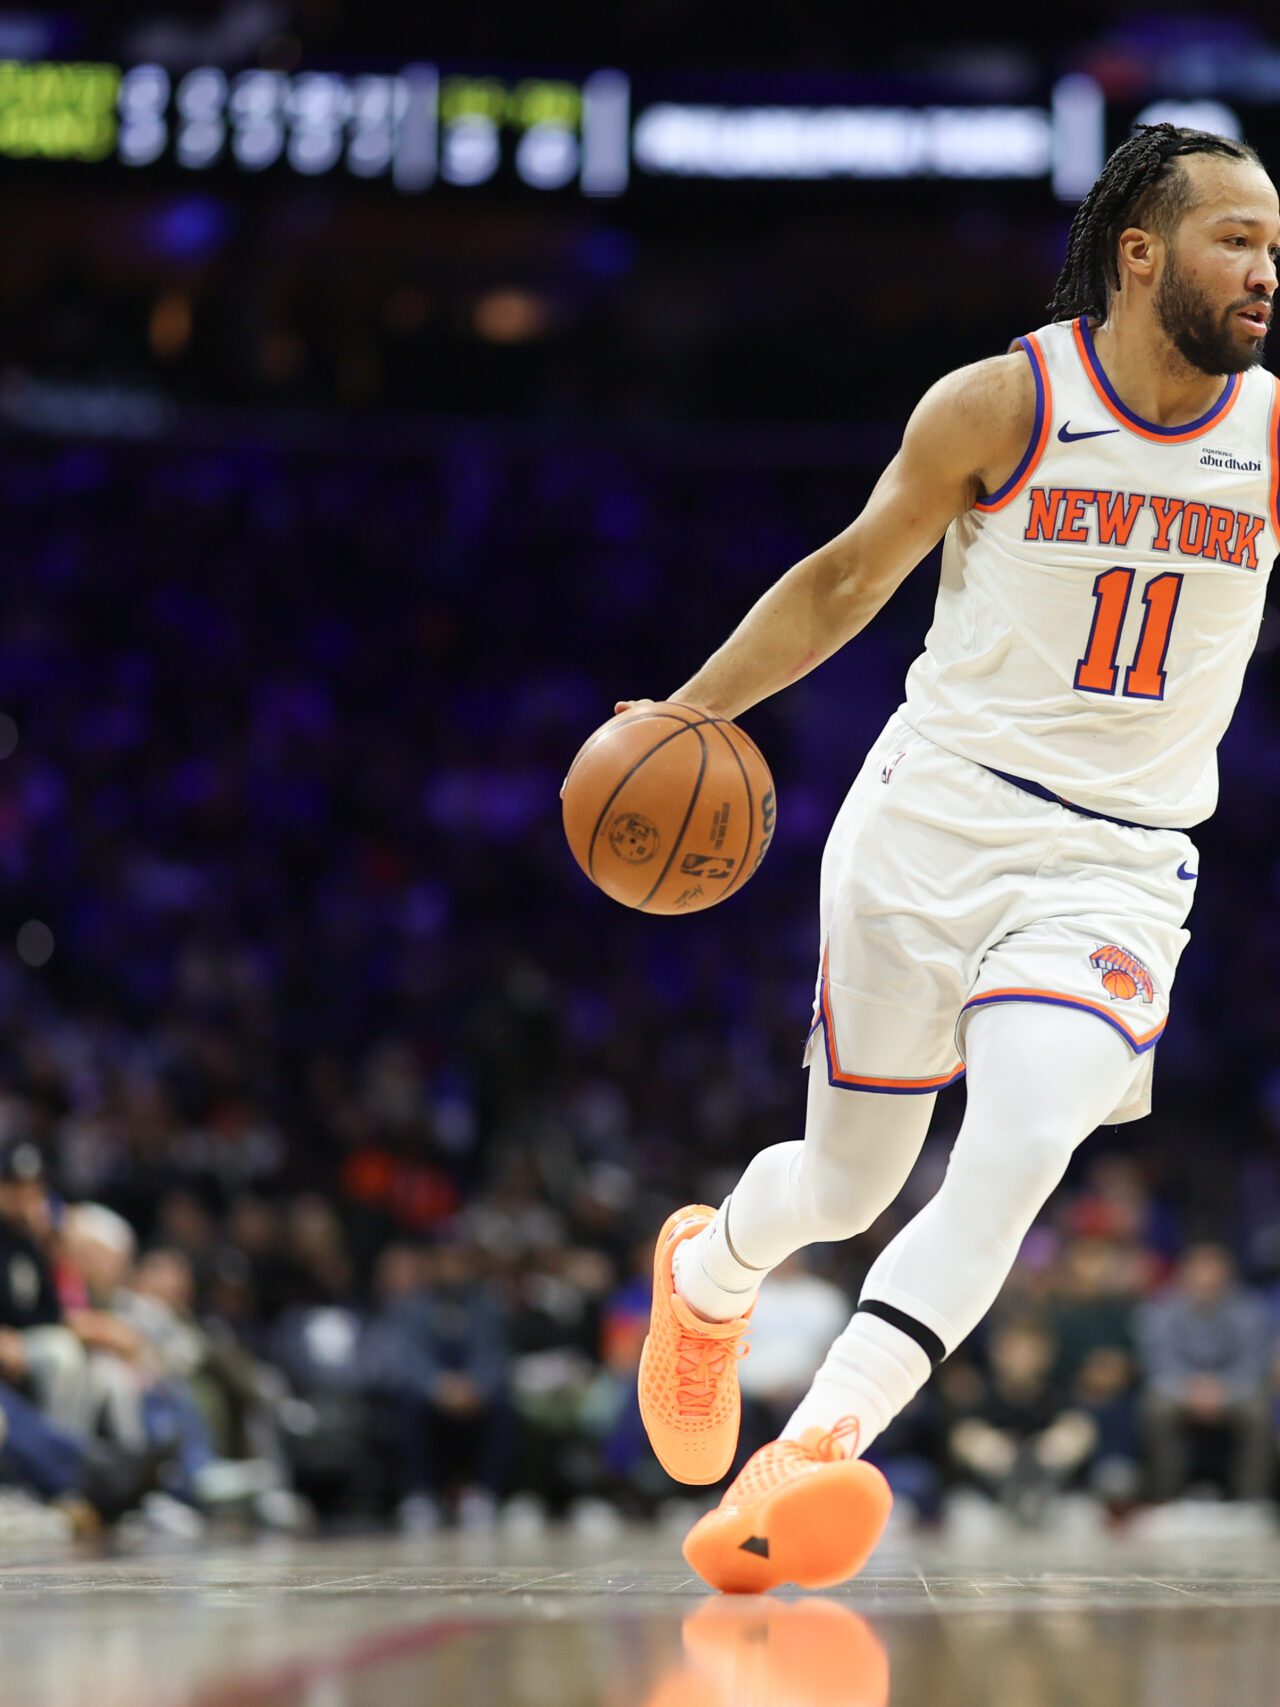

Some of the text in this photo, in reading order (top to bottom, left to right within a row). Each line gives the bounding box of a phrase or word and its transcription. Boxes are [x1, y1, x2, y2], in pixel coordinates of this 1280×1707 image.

[1200, 455, 1262, 472] abu dhabi
[1202, 447, 1233, 458] experience
[1024, 487, 1266, 571] NEW YORK
[1073, 566, 1184, 701] 11
